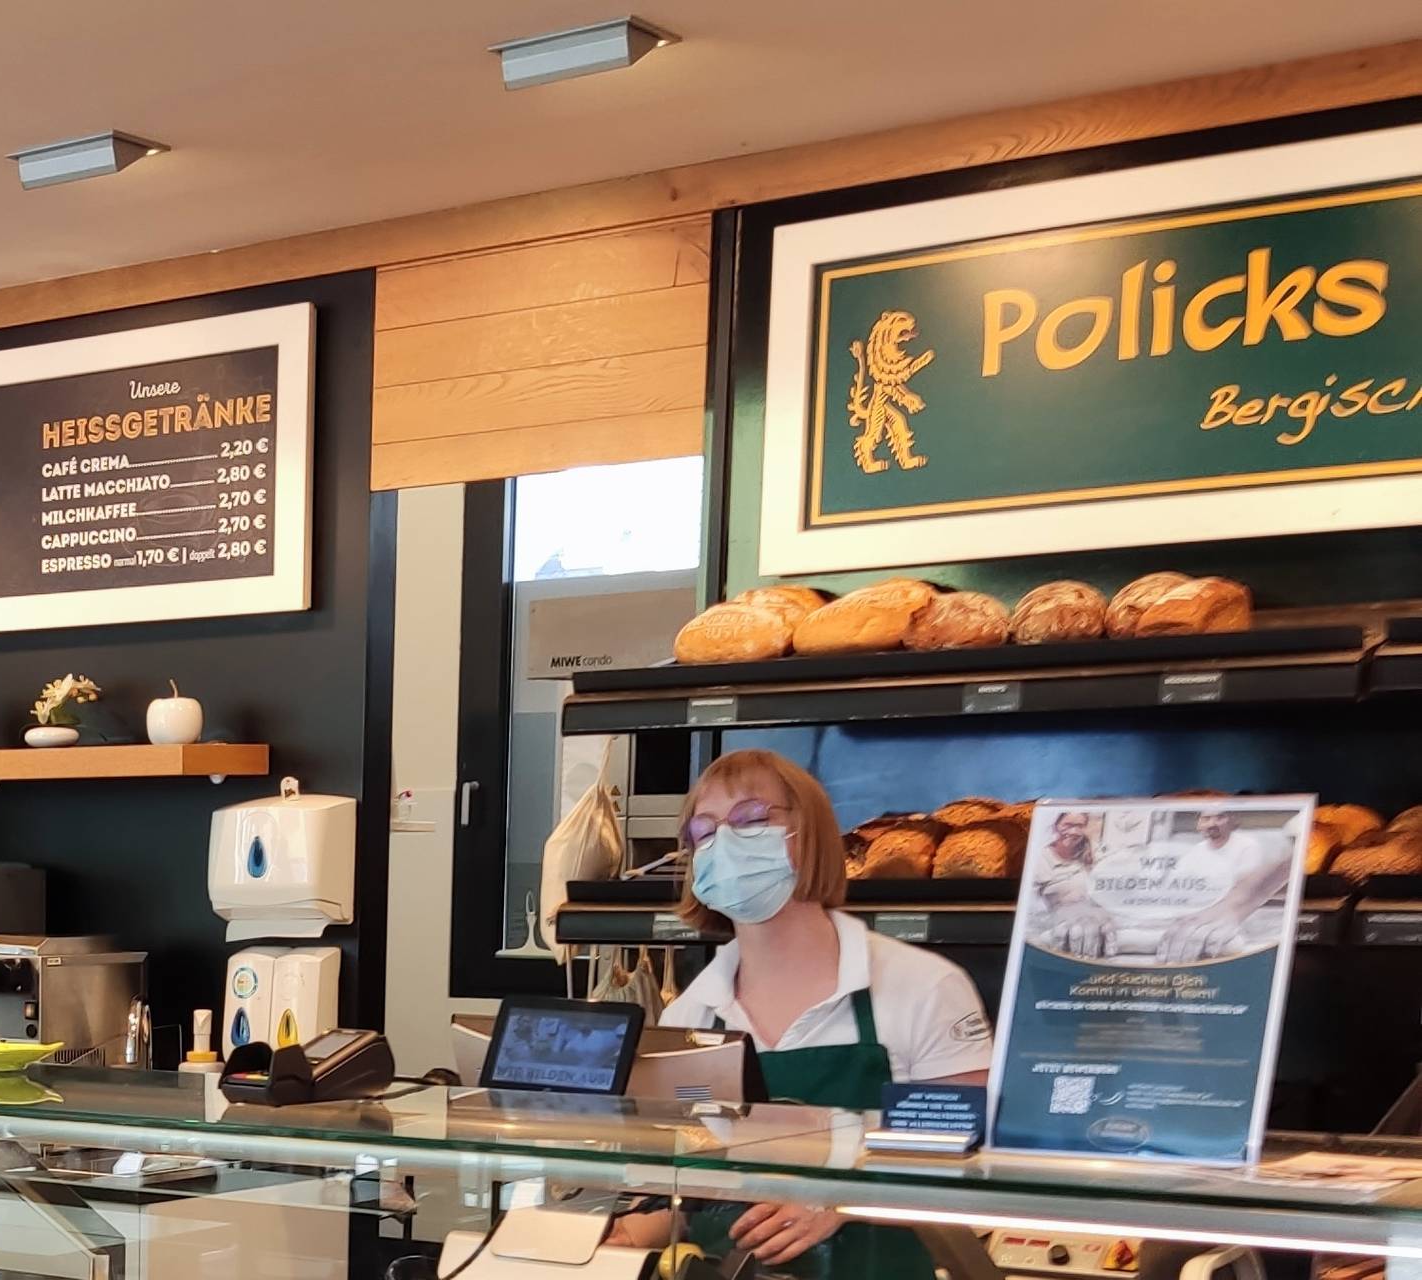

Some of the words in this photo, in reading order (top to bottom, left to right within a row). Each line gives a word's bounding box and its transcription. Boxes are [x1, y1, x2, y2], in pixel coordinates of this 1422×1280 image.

[982, 247, 1390, 378] Policks
[129, 380, 181, 400] Unsere
[1200, 372, 1422, 445] Bergisc
[42, 393, 272, 449] HEISSGETRÄNKE
[42, 456, 77, 478] CAFÉ
[80, 454, 129, 474] CREMA
[220, 439, 252, 459] 2,20
[256, 437, 269, 453] €
[41, 484, 81, 502] LATTE
[84, 475, 171, 498] MACCHIATO
[217, 465, 250, 486] 2,80
[253, 463, 267, 479] €
[41, 502, 137, 527] MILCHKAFFEE
[218, 491, 251, 511] 2,70
[254, 488, 267, 504] €
[41, 527, 137, 550] CAPPUCCINO
[218, 516, 250, 536] 2,70
[254, 514, 267, 530] €
[41, 553, 112, 574] ESPRESSO
[136, 549, 164, 568] 1,70
[167, 547, 179, 562] €
[217, 541, 250, 561] 2,80
[254, 539, 267, 555] €
[550, 656, 581, 668] MIWE
[1139, 857, 1177, 870] WIR
[1095, 878, 1162, 891] BILDEN
